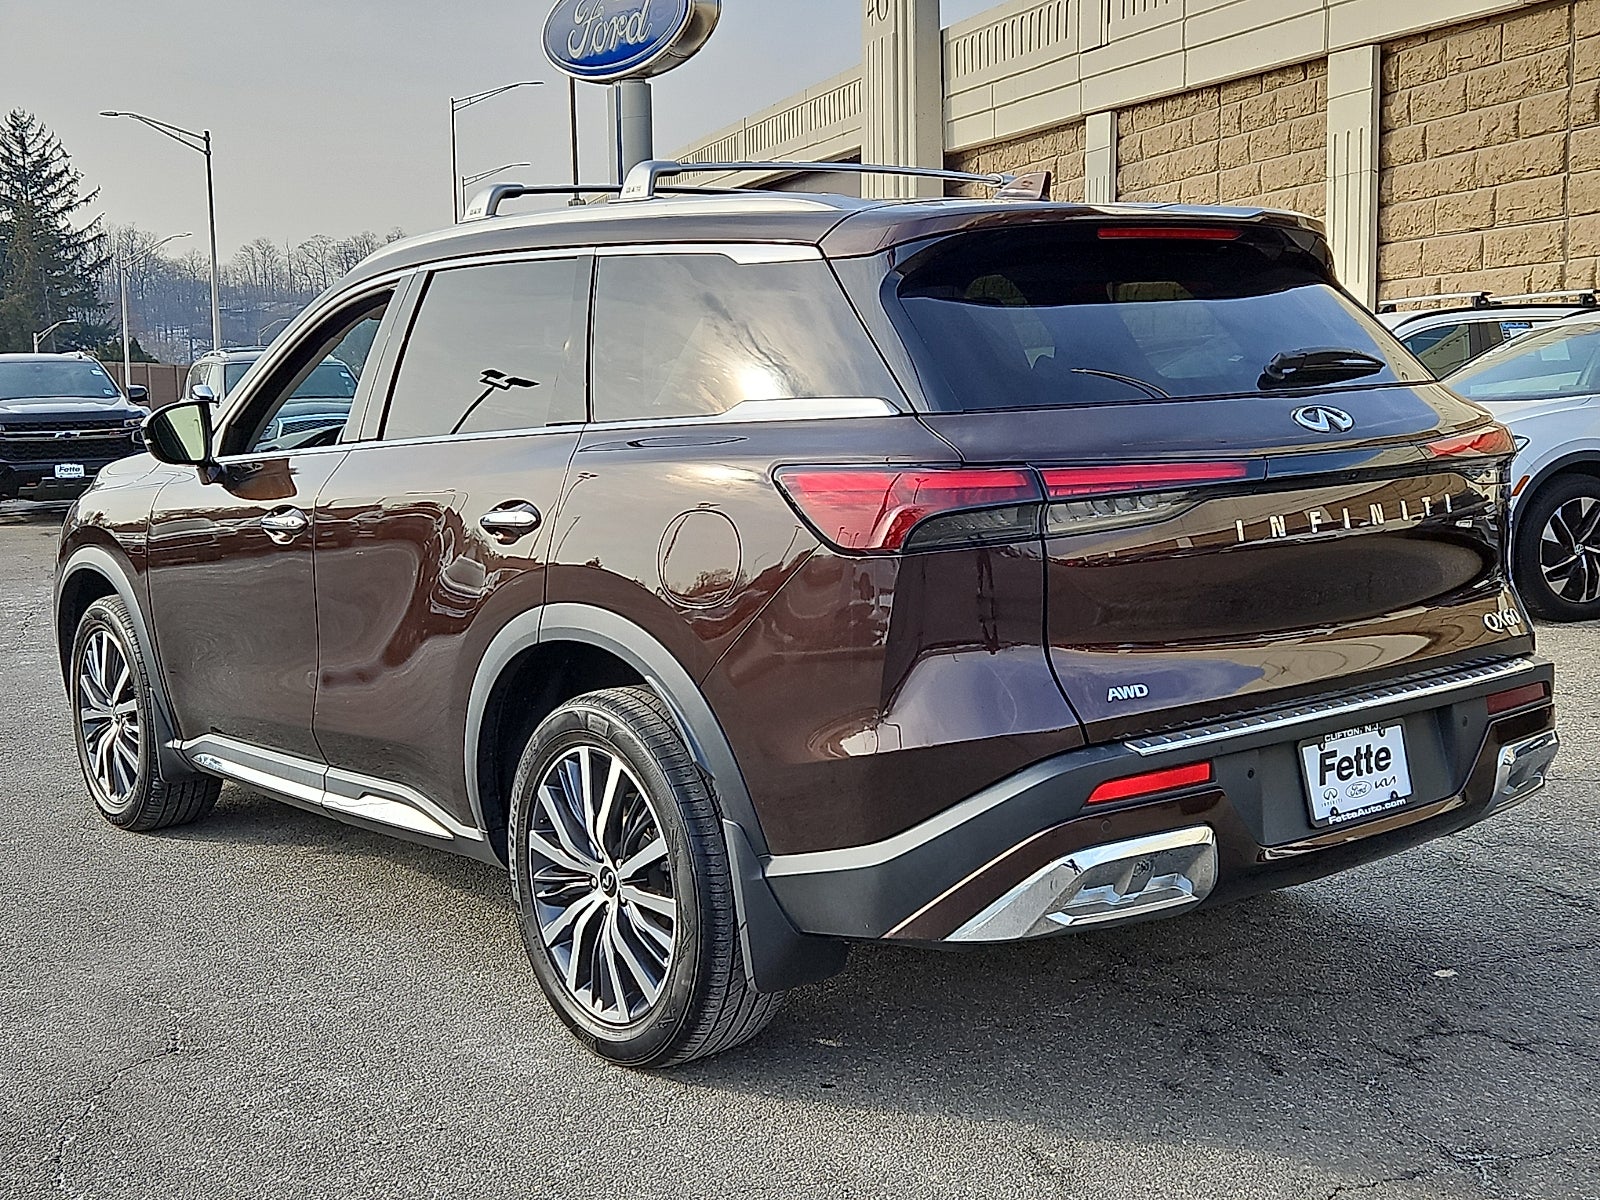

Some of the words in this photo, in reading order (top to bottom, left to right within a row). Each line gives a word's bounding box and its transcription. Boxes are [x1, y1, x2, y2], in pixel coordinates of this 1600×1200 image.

[567, 0, 653, 58] Ford
[1235, 494, 1453, 542] INFINITI
[1483, 607, 1521, 632] QX60
[1107, 683, 1149, 702] AWD
[1319, 744, 1392, 787] Fette
[1349, 783, 1369, 797] Ford
[1328, 798, 1406, 824] FetteAuto.com
